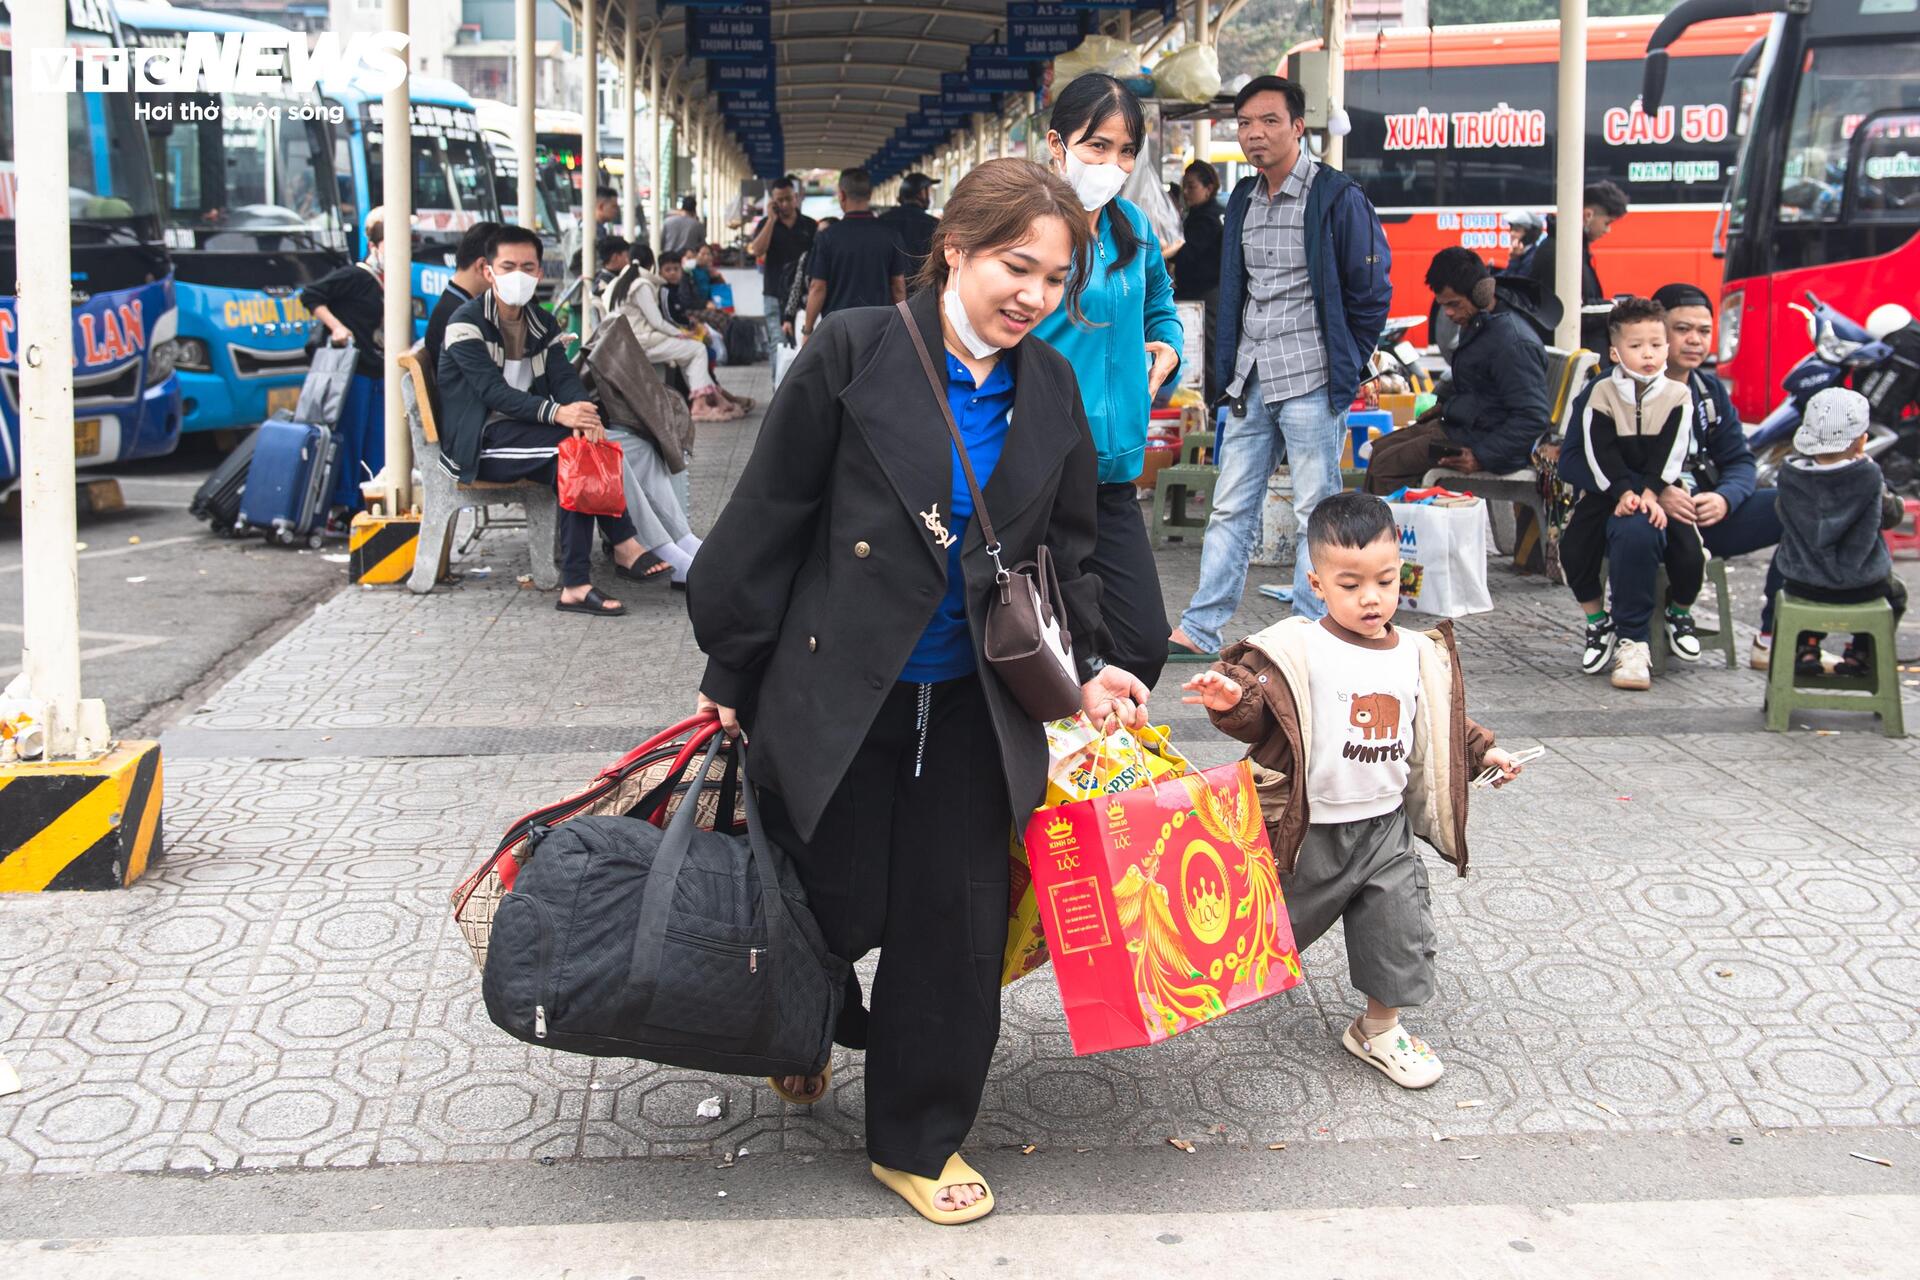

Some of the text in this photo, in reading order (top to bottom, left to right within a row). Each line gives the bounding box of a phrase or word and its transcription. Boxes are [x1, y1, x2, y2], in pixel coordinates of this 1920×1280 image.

[1027, 23, 1058, 36] THANH
[734, 39, 764, 51] LONG
[1384, 102, 1546, 150] XUÂN TRƯỜNG
[1681, 103, 1729, 143] 50
[1629, 160, 1720, 184] NAM ĐỊNH
[1461, 231, 1498, 249] 0919
[78, 300, 145, 366] LAN
[1342, 739, 1405, 764] WINTER
[1048, 839, 1067, 849] KINH
[1113, 833, 1132, 850] LỘC
[1056, 853, 1081, 872] LỘC
[1198, 897, 1221, 928] LỘC
